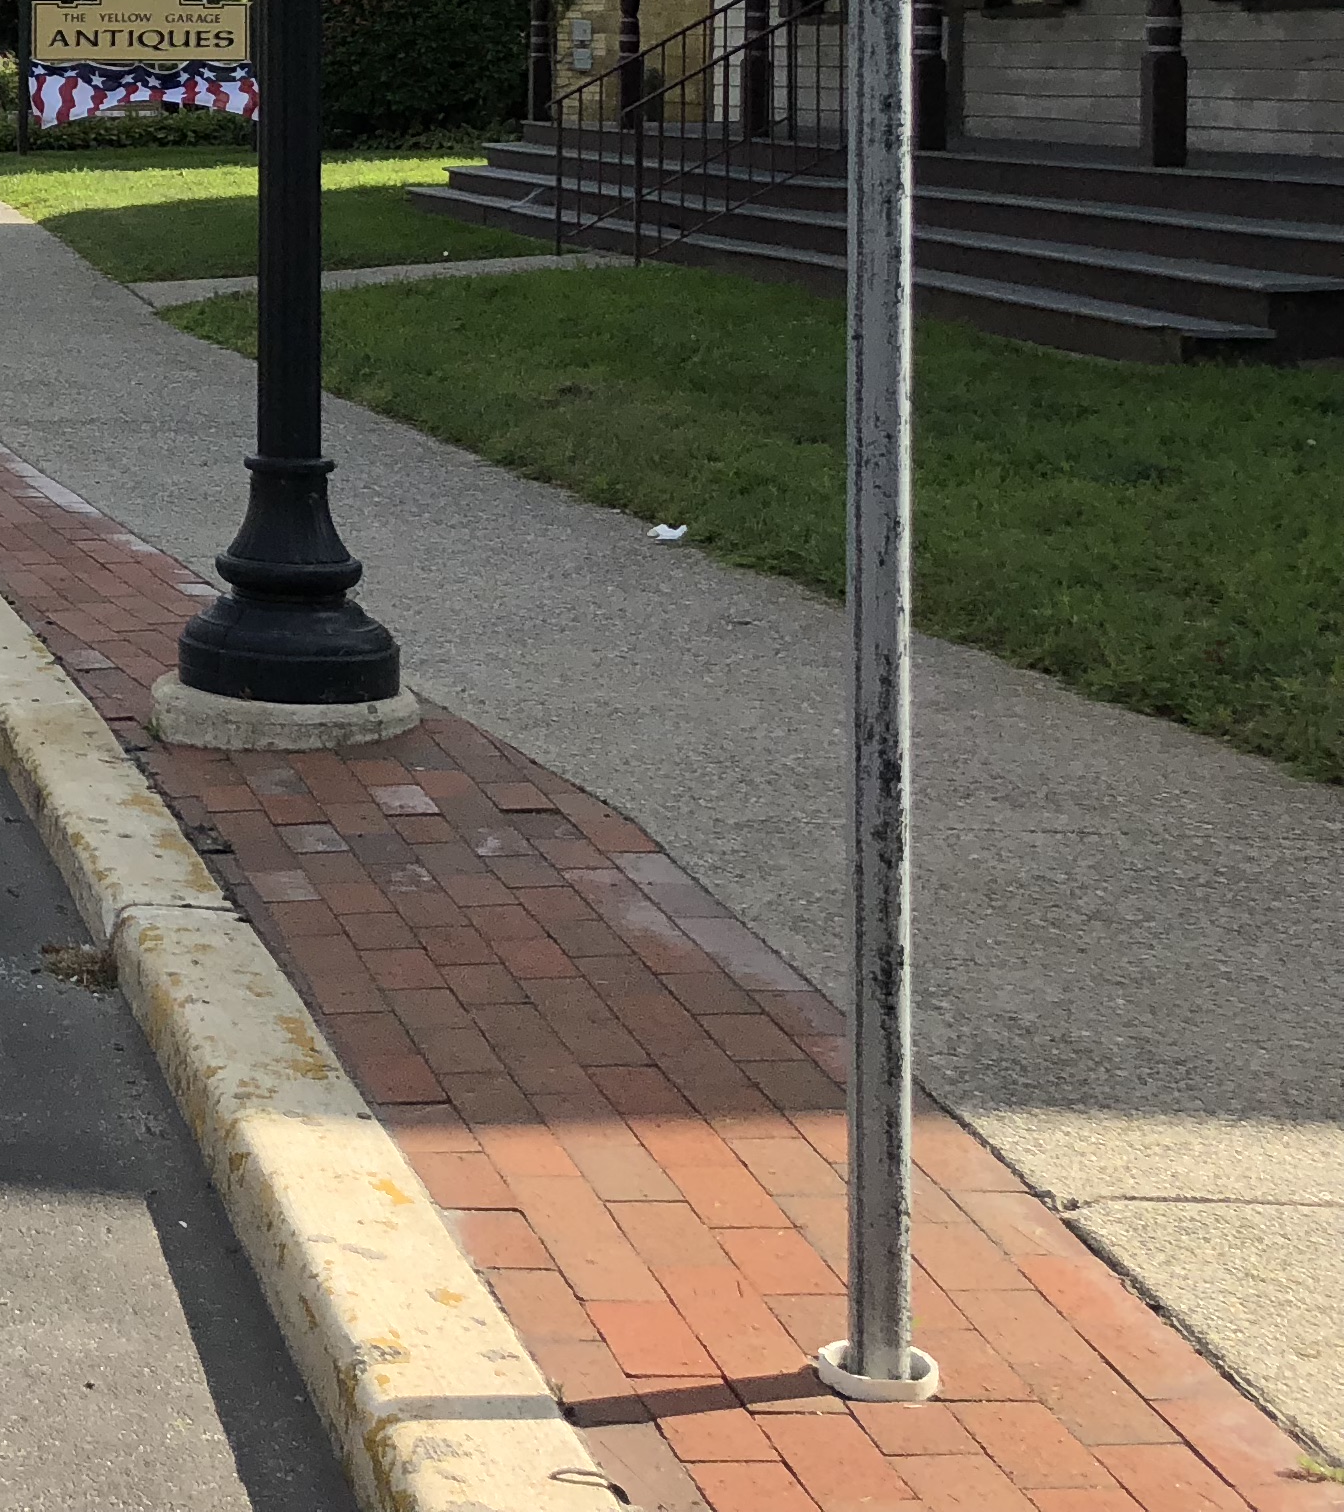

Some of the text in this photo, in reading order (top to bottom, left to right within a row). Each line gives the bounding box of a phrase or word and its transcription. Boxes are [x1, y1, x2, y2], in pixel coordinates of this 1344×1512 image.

[63, 12, 221, 24] THE YELLOW GARAGE
[48, 29, 235, 51] ANTIQUES
